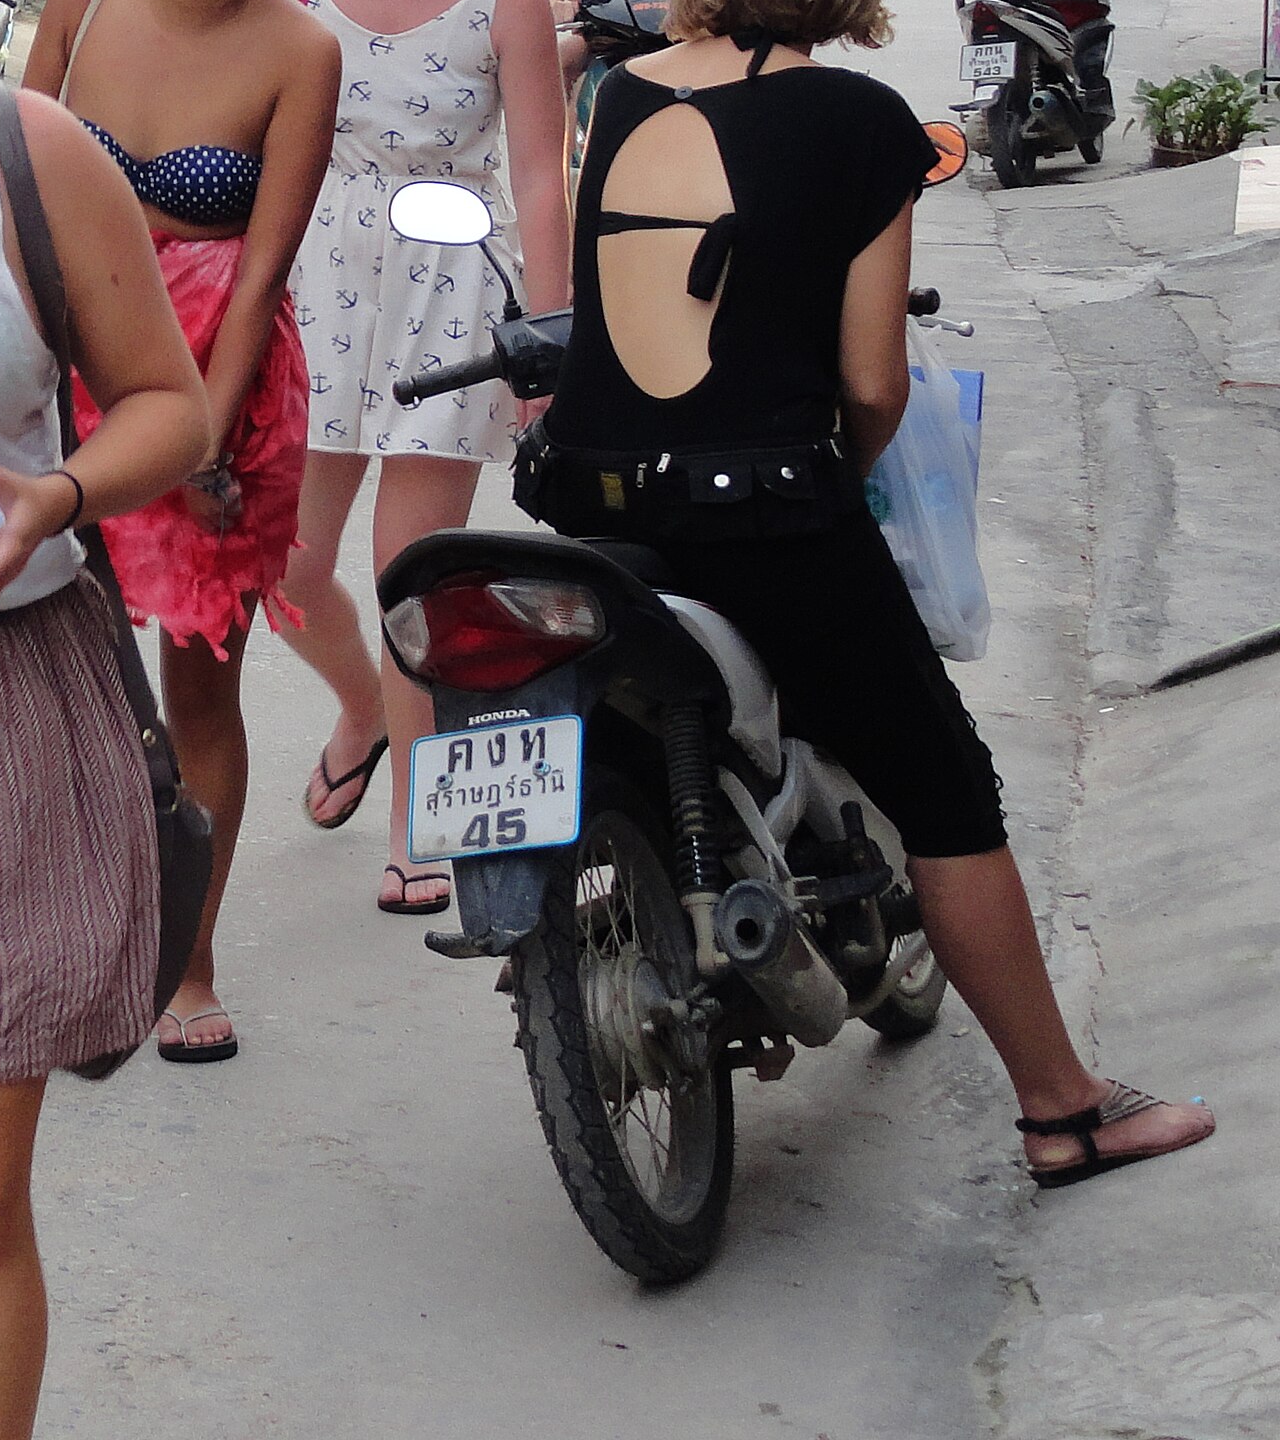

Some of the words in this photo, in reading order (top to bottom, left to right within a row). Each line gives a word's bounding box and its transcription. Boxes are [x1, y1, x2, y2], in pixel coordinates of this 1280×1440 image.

[973, 66, 1002, 77] 543
[467, 708, 531, 726] HONDA
[447, 726, 547, 773] คงท
[461, 807, 528, 849] 45
